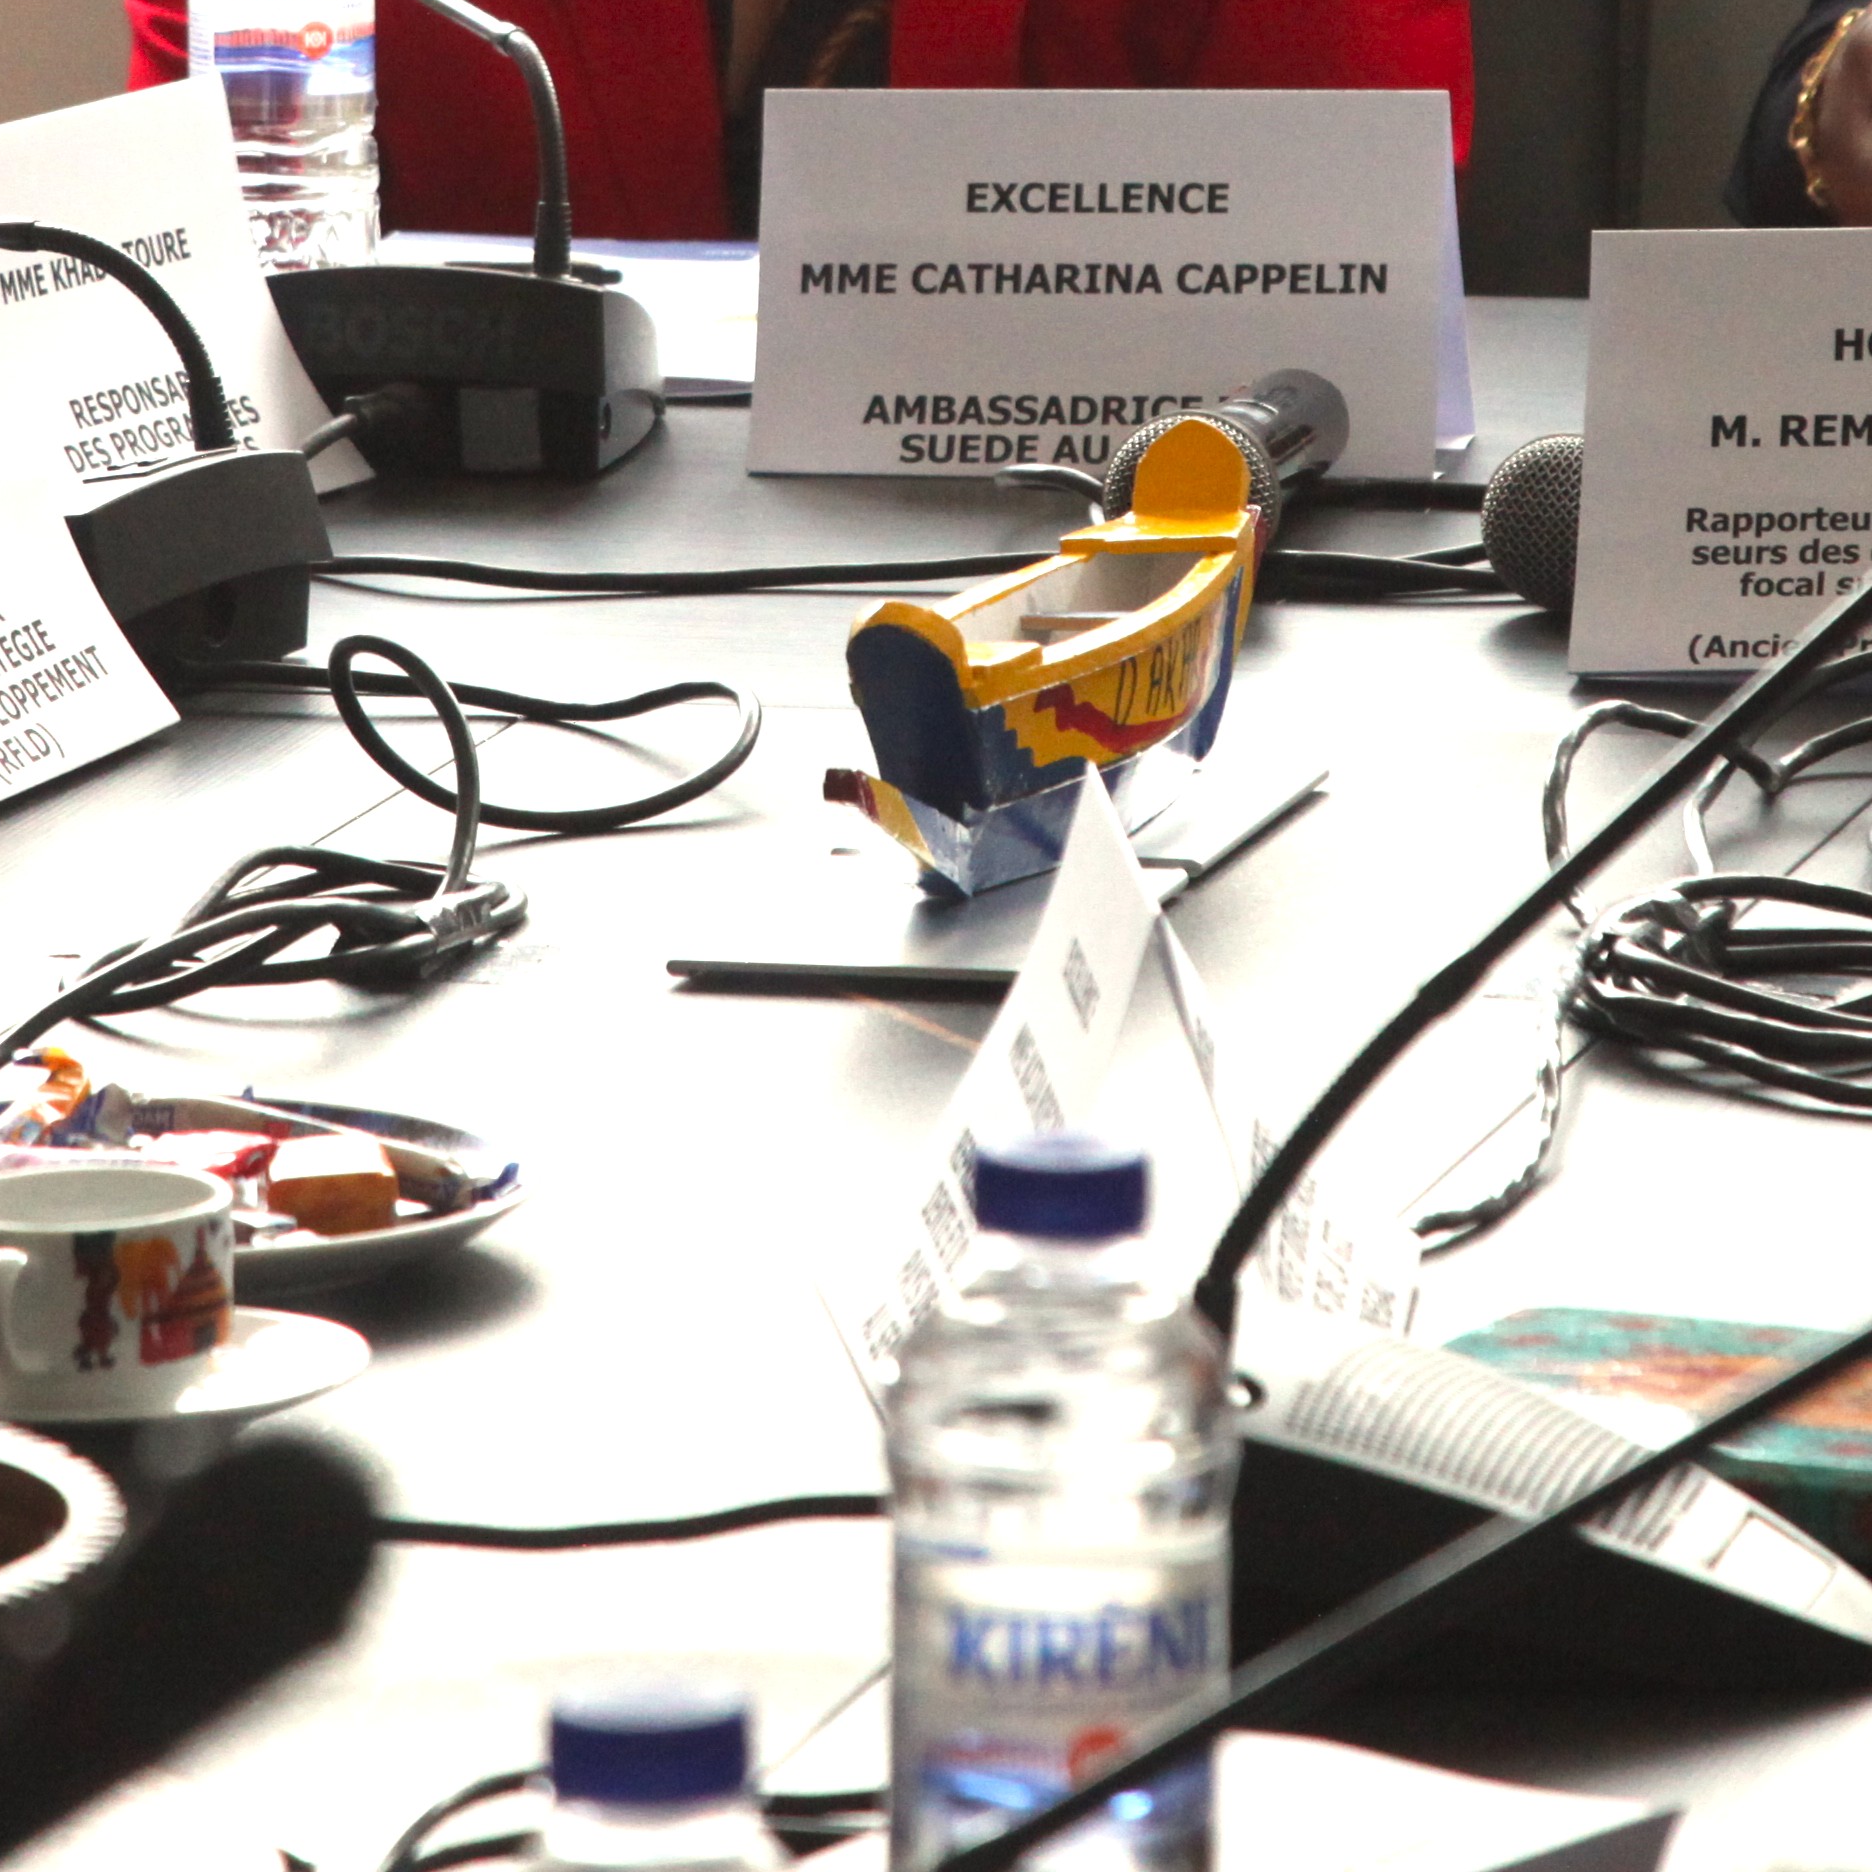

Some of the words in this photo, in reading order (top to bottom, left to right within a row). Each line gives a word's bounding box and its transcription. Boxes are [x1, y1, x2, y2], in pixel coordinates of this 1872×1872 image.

[966, 182, 1230, 215] EXCELLENCE
[0, 263, 49, 305] MME
[800, 263, 897, 296] MME
[912, 262, 1163, 296] CATHARINA
[1176, 262, 1389, 296] CAPPELIN
[1709, 414, 1762, 449] M.
[63, 436, 113, 474] DES
[900, 433, 1038, 465] SUEDE
[1056, 433, 1111, 465] AU
[1691, 540, 1793, 566] seurs
[1798, 537, 1860, 565] des
[1740, 569, 1825, 598] focal
